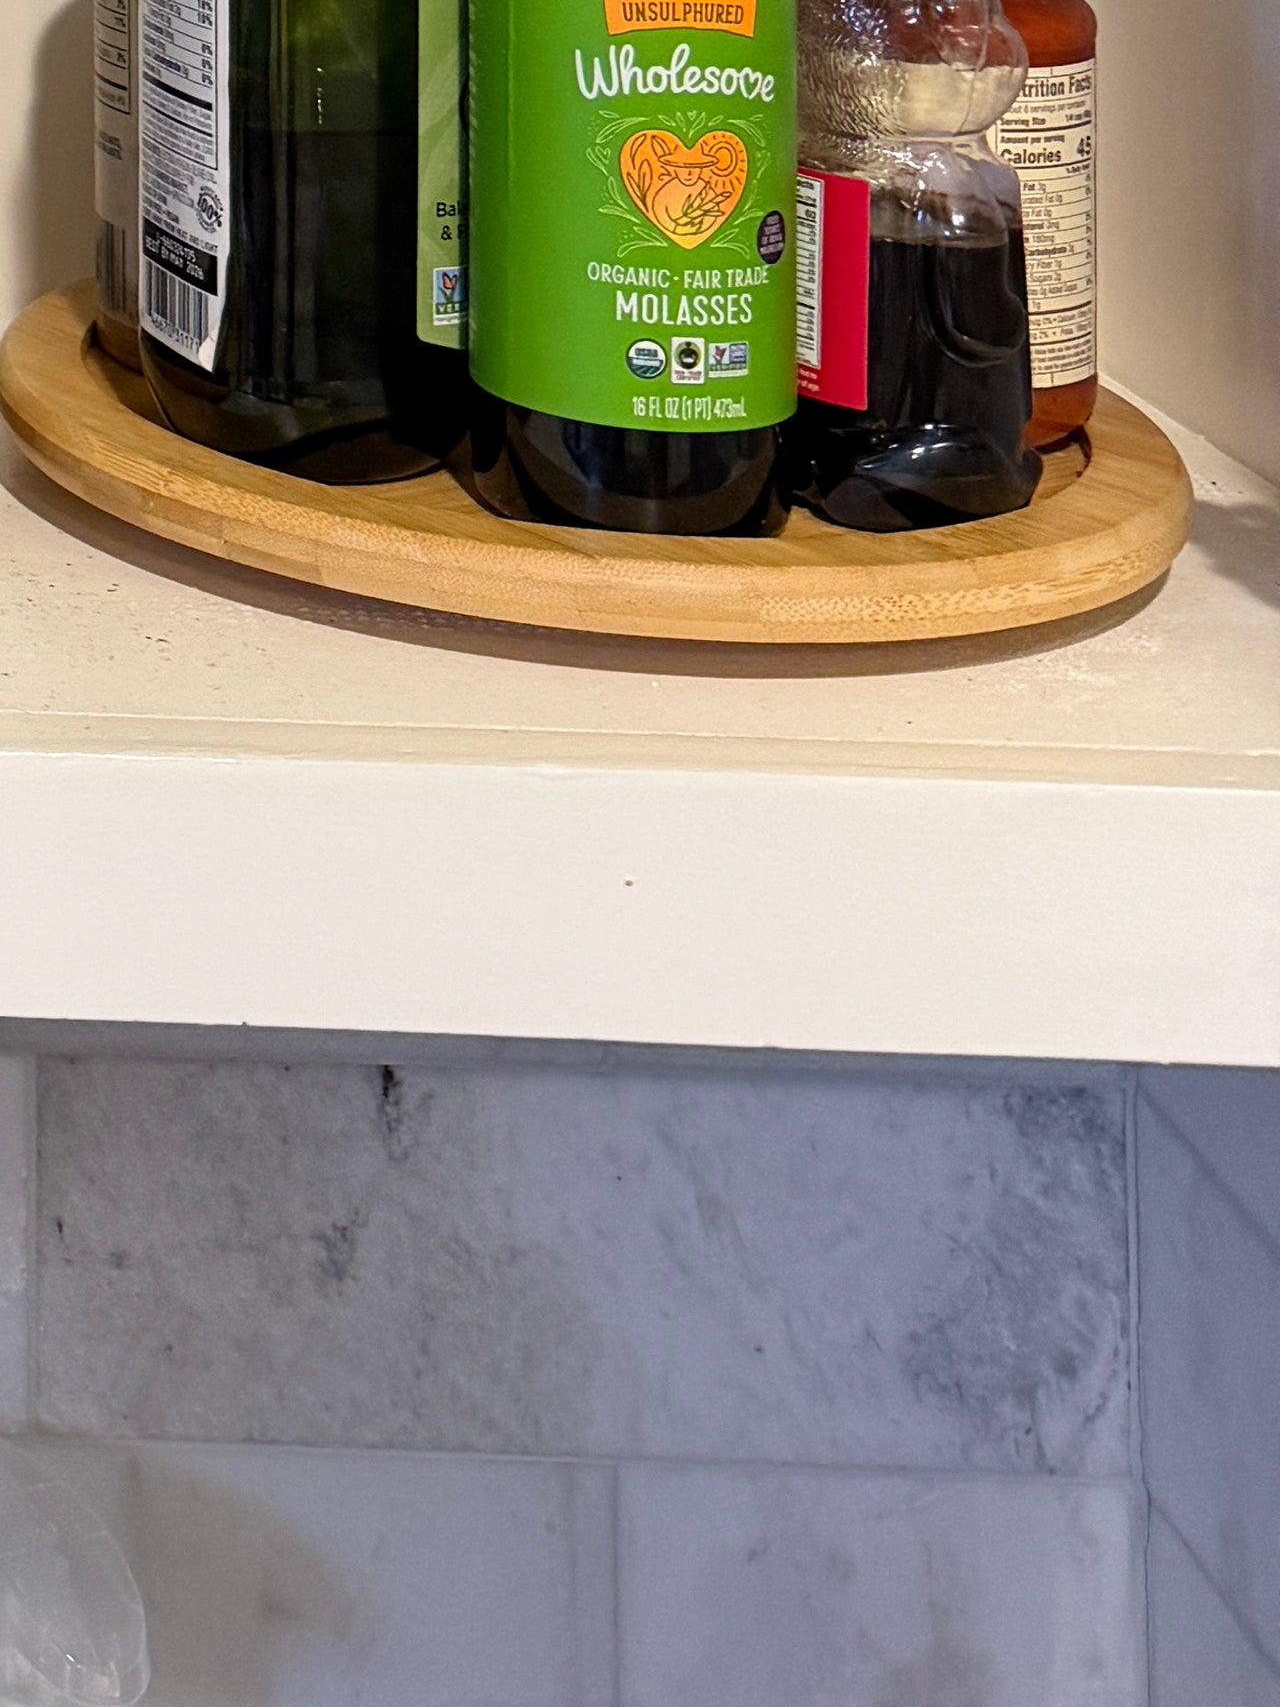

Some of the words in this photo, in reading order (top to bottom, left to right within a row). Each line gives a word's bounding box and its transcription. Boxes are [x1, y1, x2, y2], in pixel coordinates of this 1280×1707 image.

[622, 2, 743, 24] UNSULPHURED
[575, 43, 774, 102] Wholesome
[1001, 148, 1061, 164] Calories
[197, 194, 222, 228] 100%
[587, 262, 670, 287] ORGANIC
[684, 270, 721, 288] FAIR
[726, 266, 769, 286] TRADE
[616, 291, 753, 326] MOLASSES
[632, 397, 645, 416] 16
[650, 397, 661, 417] FL
[665, 399, 679, 418] OZ
[682, 399, 692, 421] (1
[696, 398, 711, 420] PT)
[714, 397, 746, 417] 473mL
